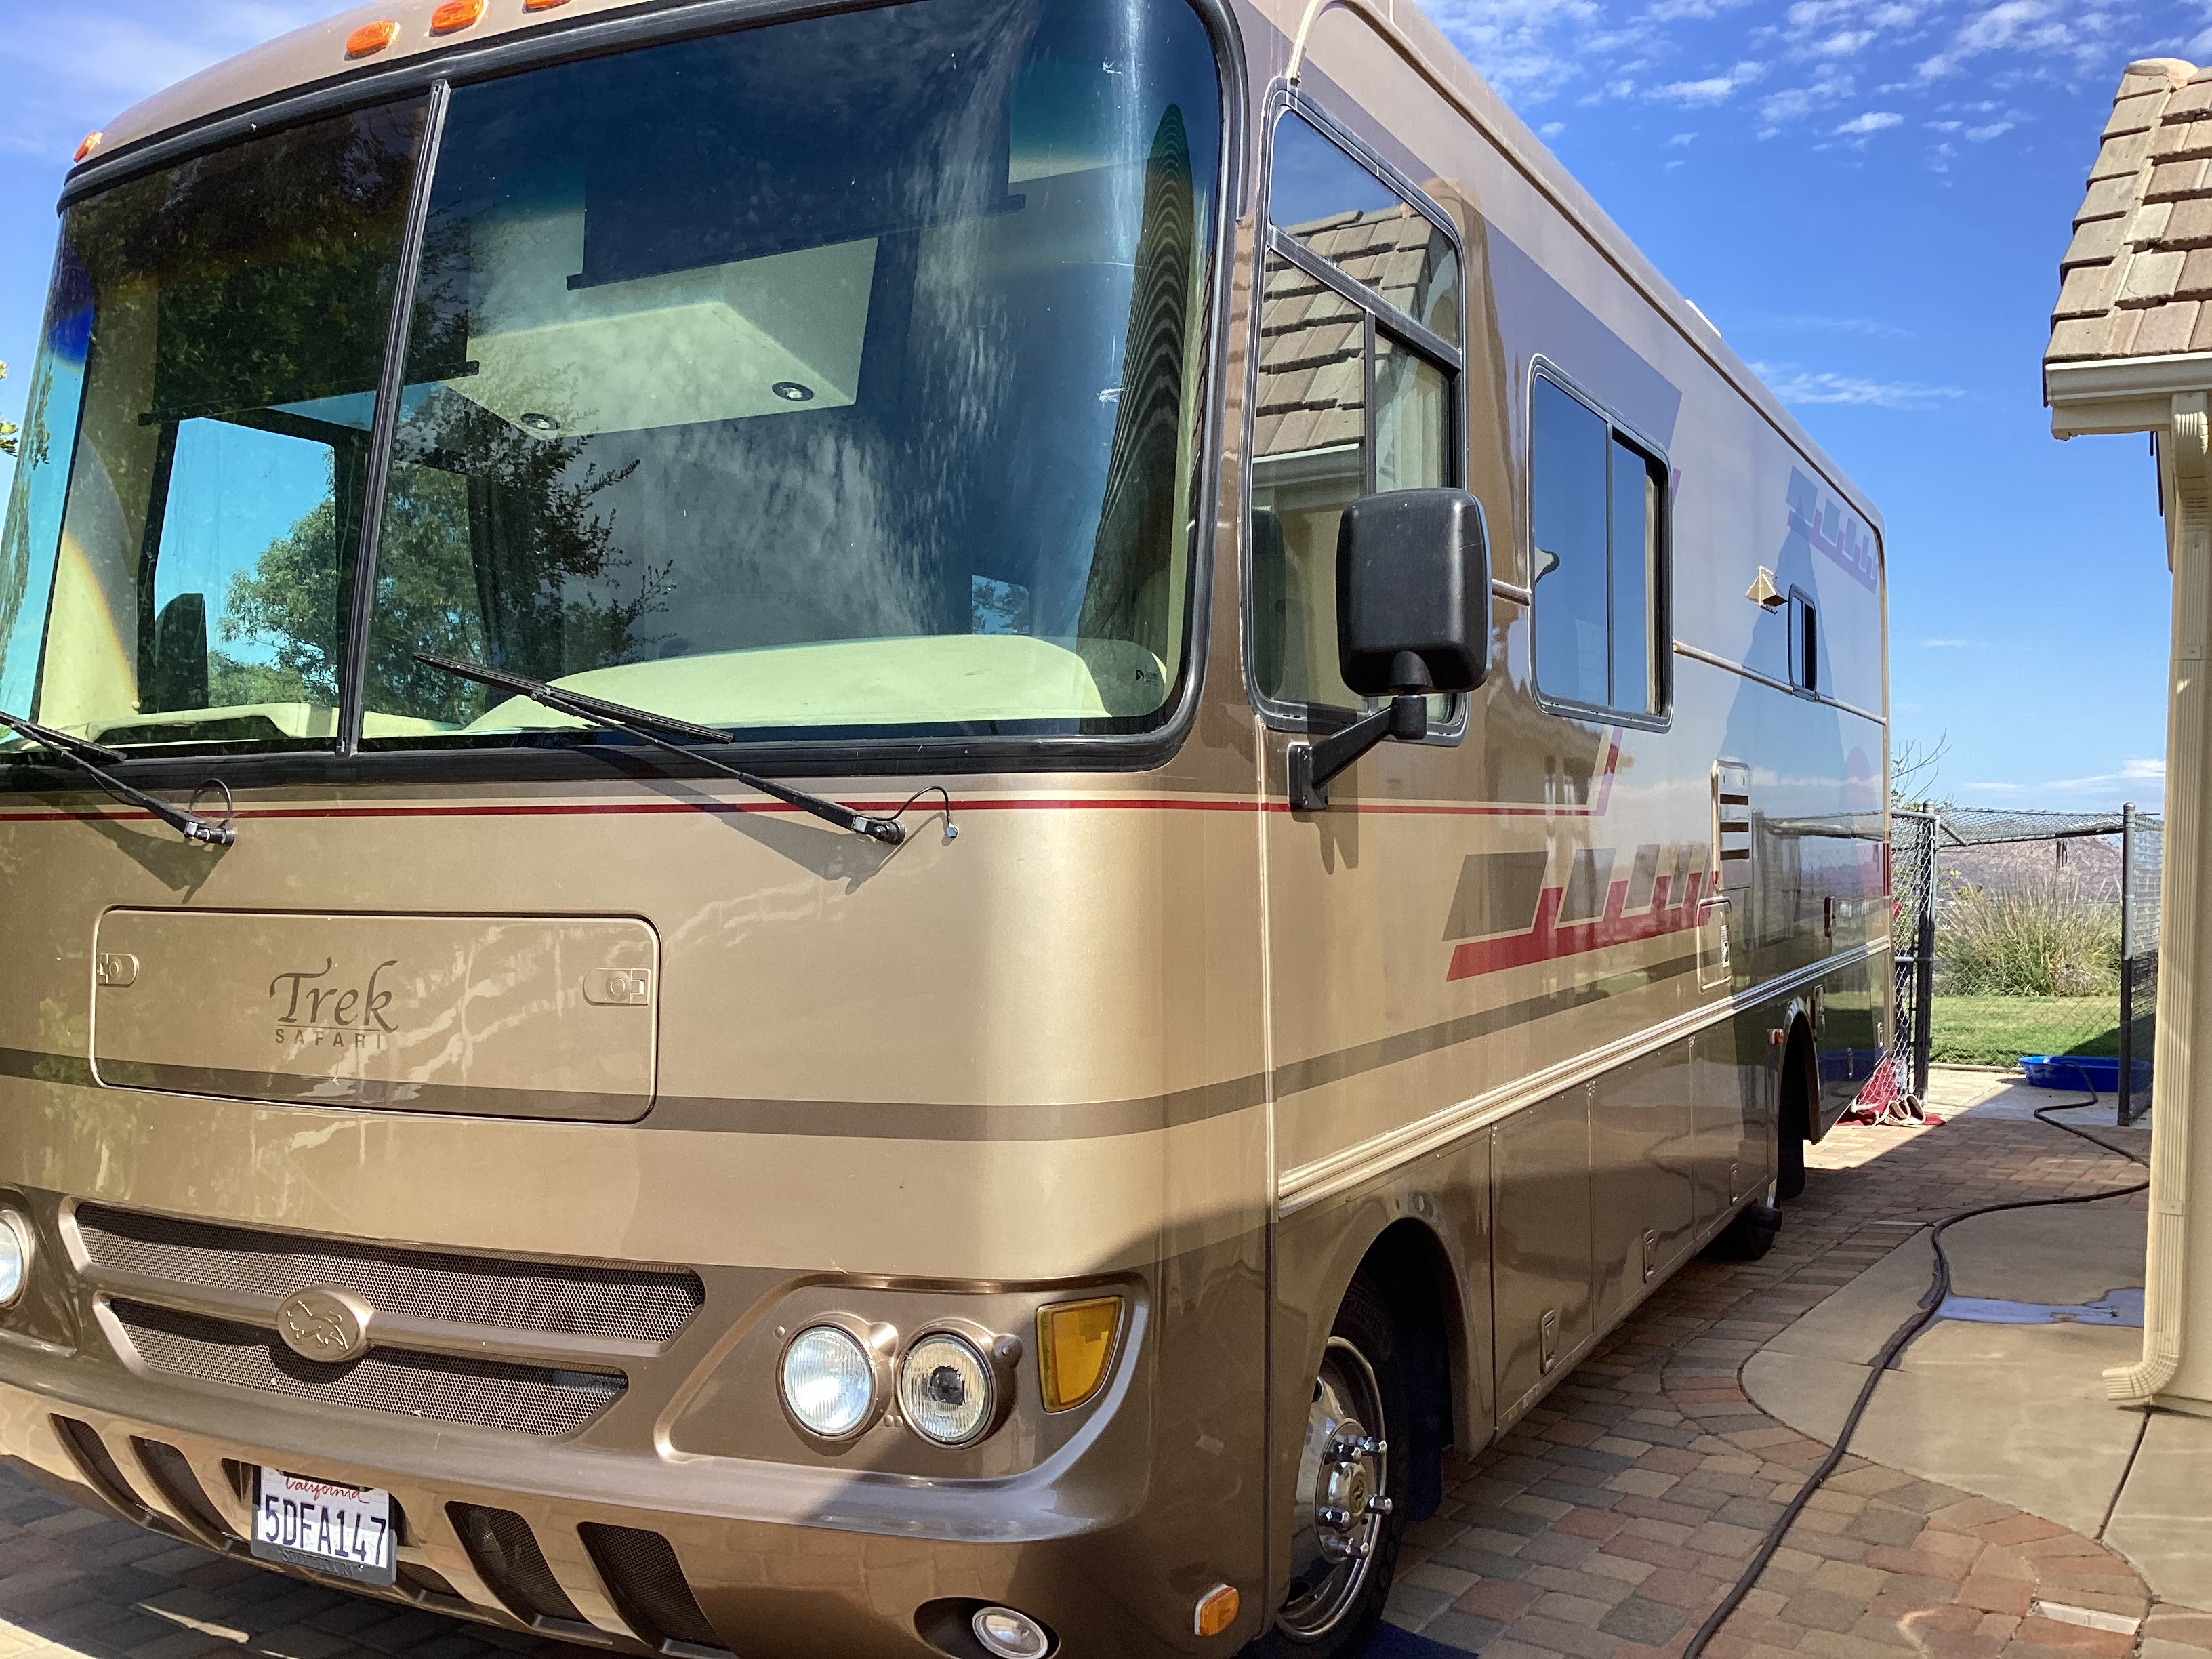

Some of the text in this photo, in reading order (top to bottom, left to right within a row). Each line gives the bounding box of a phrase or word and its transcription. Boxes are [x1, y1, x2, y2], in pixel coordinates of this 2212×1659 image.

[270, 957, 398, 1033] Trek
[275, 1028, 381, 1050] SAFARI
[285, 1475, 371, 1504] California
[266, 1494, 386, 1565] 5DFA147
